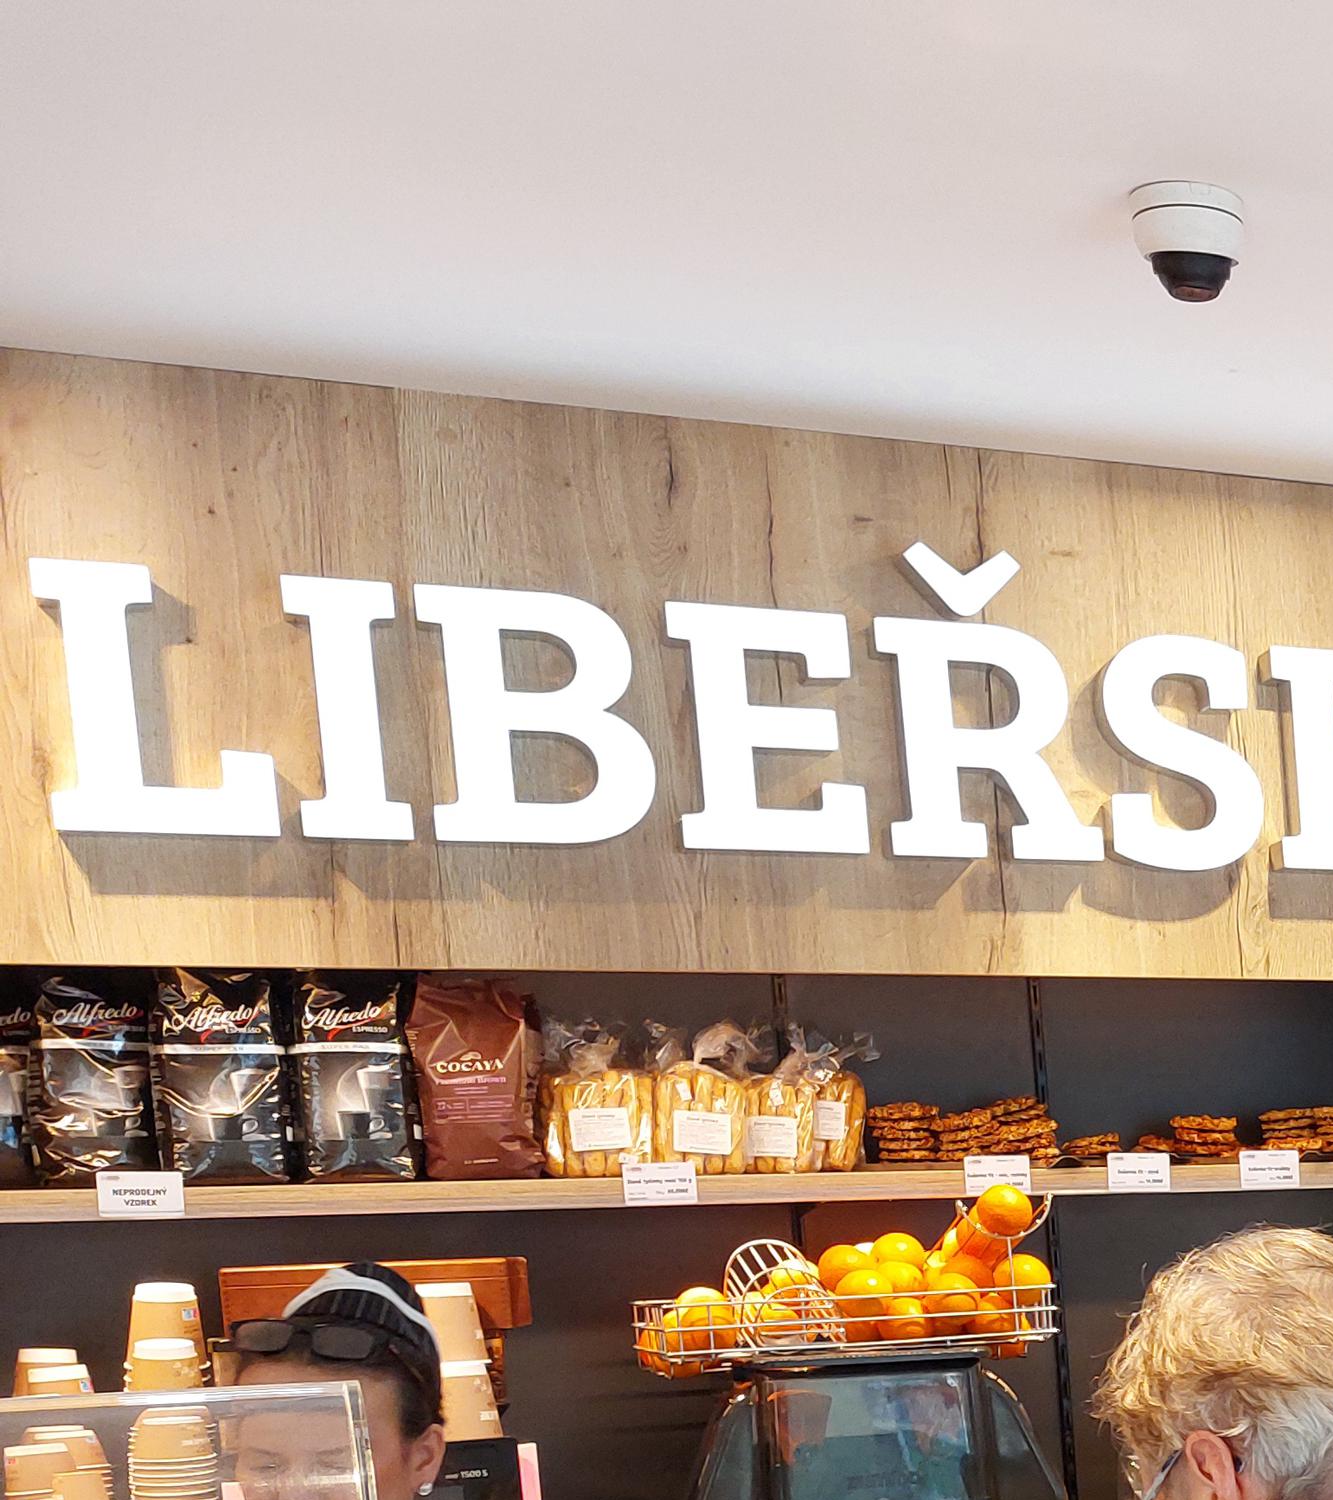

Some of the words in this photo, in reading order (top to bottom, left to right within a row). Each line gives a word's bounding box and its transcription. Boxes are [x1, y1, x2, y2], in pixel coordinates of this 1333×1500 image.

[53, 1001, 138, 1027] Alfredo
[172, 1003, 255, 1031] Alfredo
[302, 1001, 381, 1029] Alfredo
[435, 1059, 504, 1073] COCAYA
[112, 1187, 168, 1197] NEPRODEJNÝ
